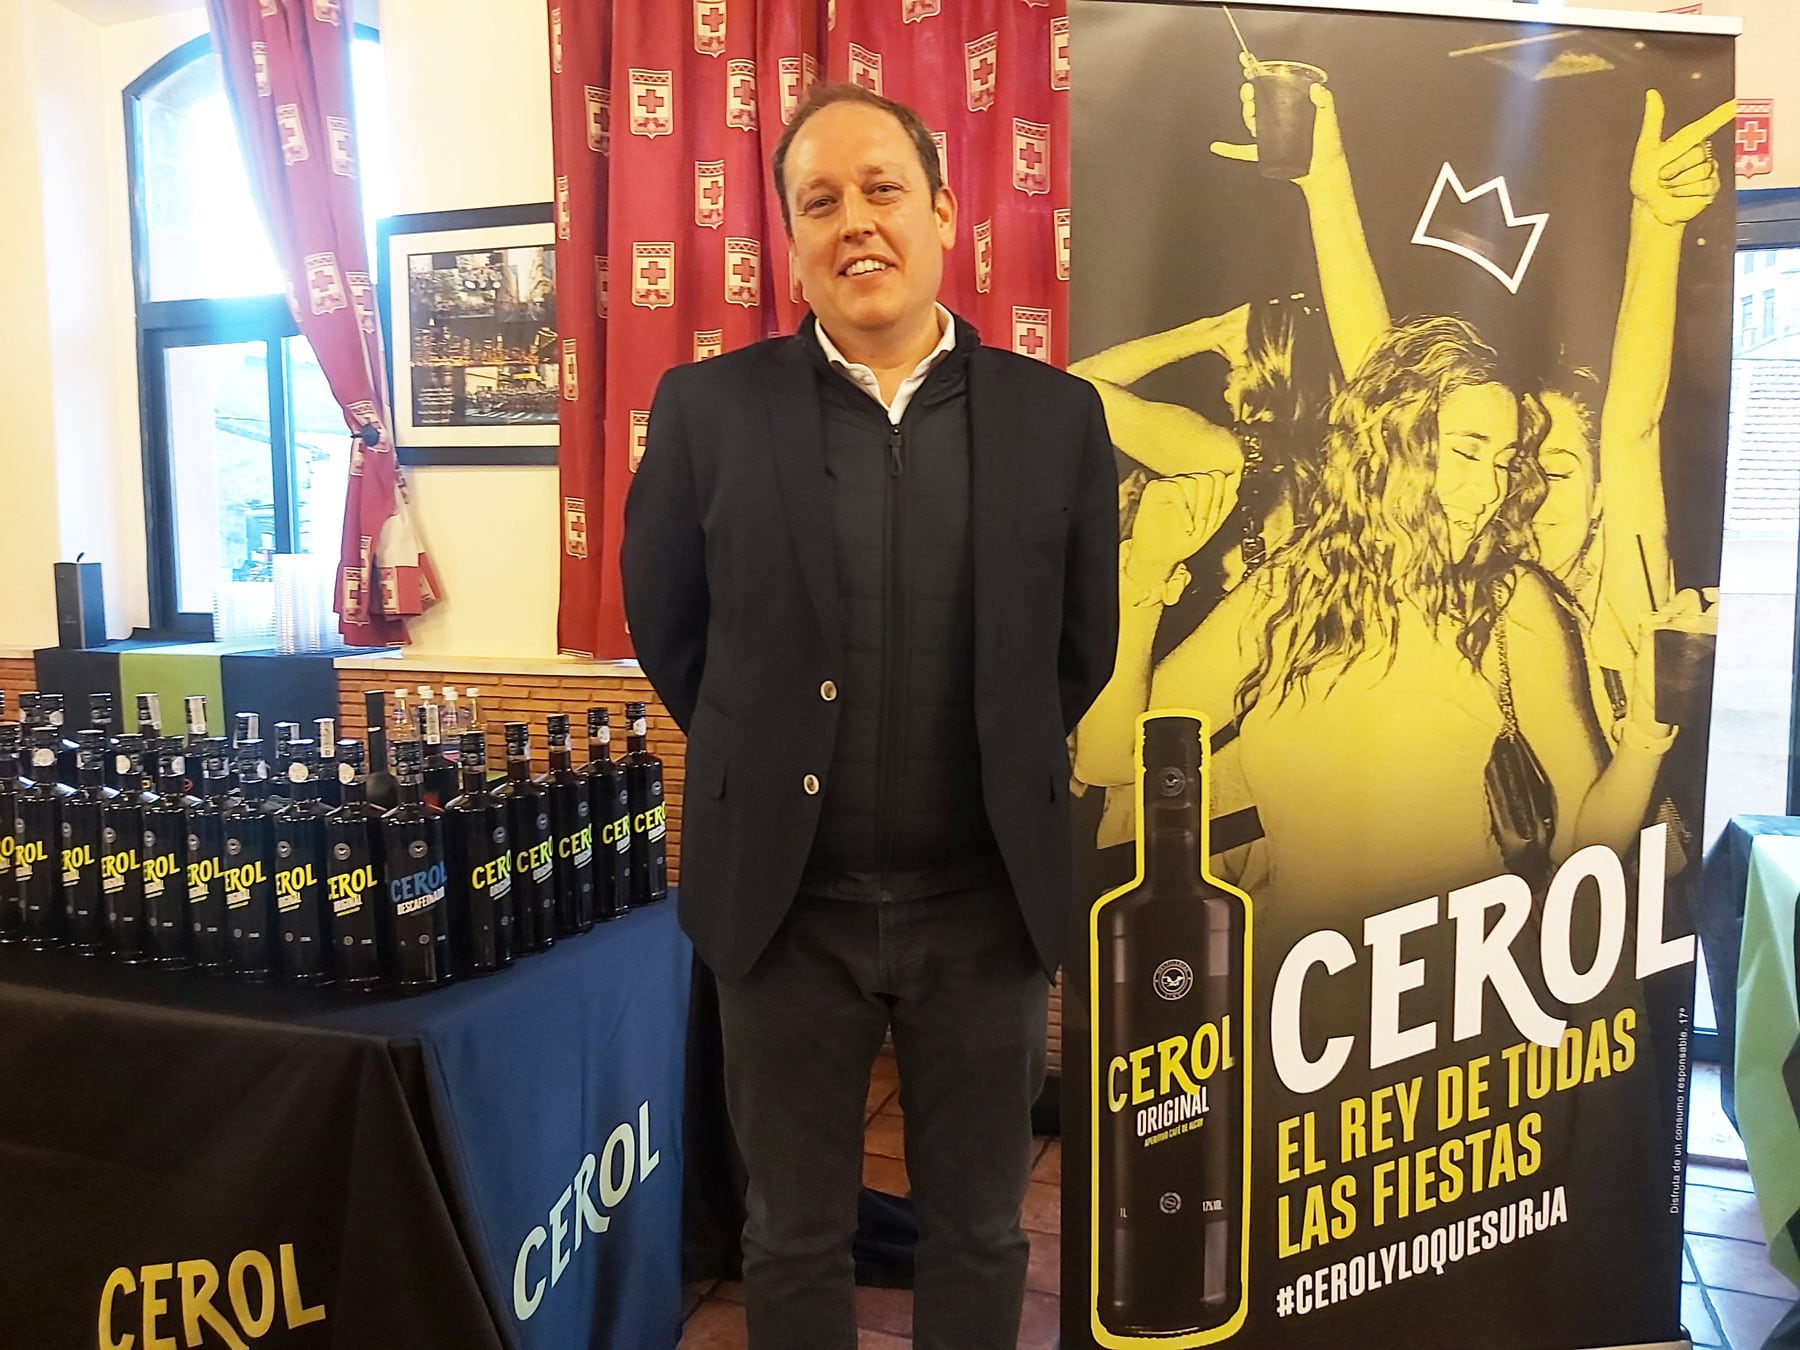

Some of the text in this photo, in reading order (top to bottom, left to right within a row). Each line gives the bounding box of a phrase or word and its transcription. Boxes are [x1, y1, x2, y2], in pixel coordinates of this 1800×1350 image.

[15, 841, 48, 867] ROL
[62, 845, 95, 871] ROL
[327, 864, 378, 900] EROL
[390, 861, 448, 902] CEROL
[1271, 822, 1695, 1094] CEROL
[1107, 1014, 1235, 1113] CEROL
[1137, 1086, 1210, 1137] ORIGINAL
[1277, 1008, 1636, 1184] EL REY DE TODAS
[1675, 1095, 1685, 1141] consumo
[1674, 1144, 1682, 1157] un
[1674, 1159, 1681, 1172] de
[1278, 1112, 1543, 1259] LAS FIESTAS
[1670, 1174, 1681, 1214] Disfruta
[513, 1100, 660, 1321] CEROL
[1277, 1185, 1568, 1318] #CEROLYLOQUESURJA
[98, 1243, 326, 1350] CEROL
